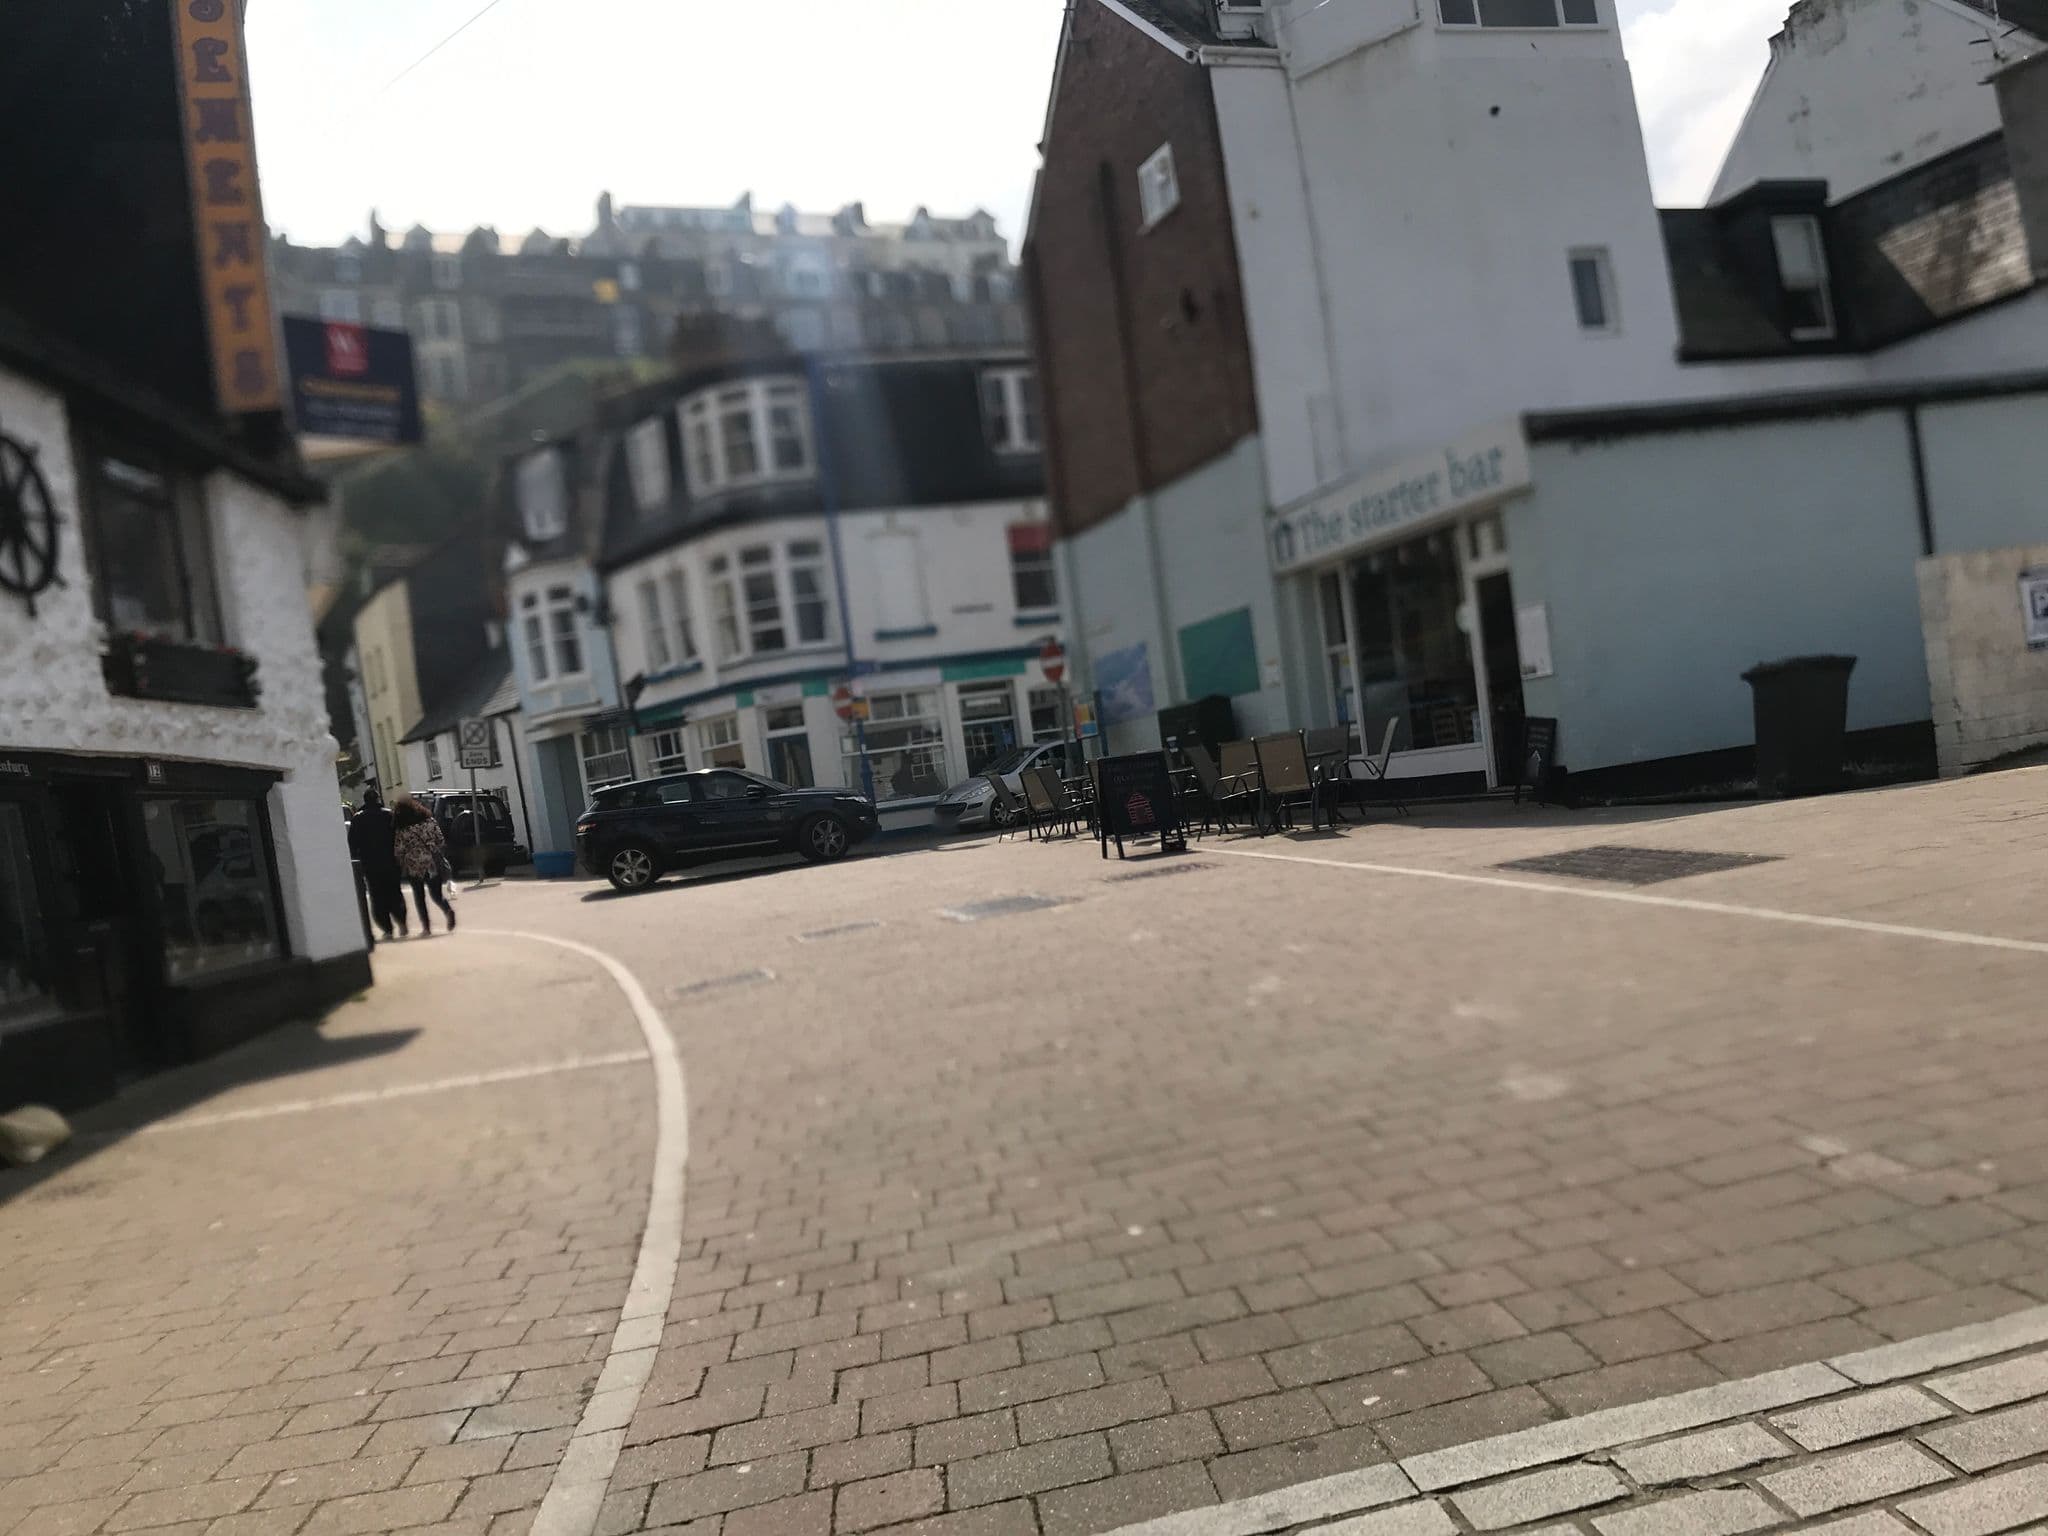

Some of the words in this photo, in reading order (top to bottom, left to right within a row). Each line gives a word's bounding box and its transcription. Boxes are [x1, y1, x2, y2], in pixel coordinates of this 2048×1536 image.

[1296, 507, 1343, 553] The
[1349, 470, 1442, 537] starter
[1445, 445, 1503, 498] bar
